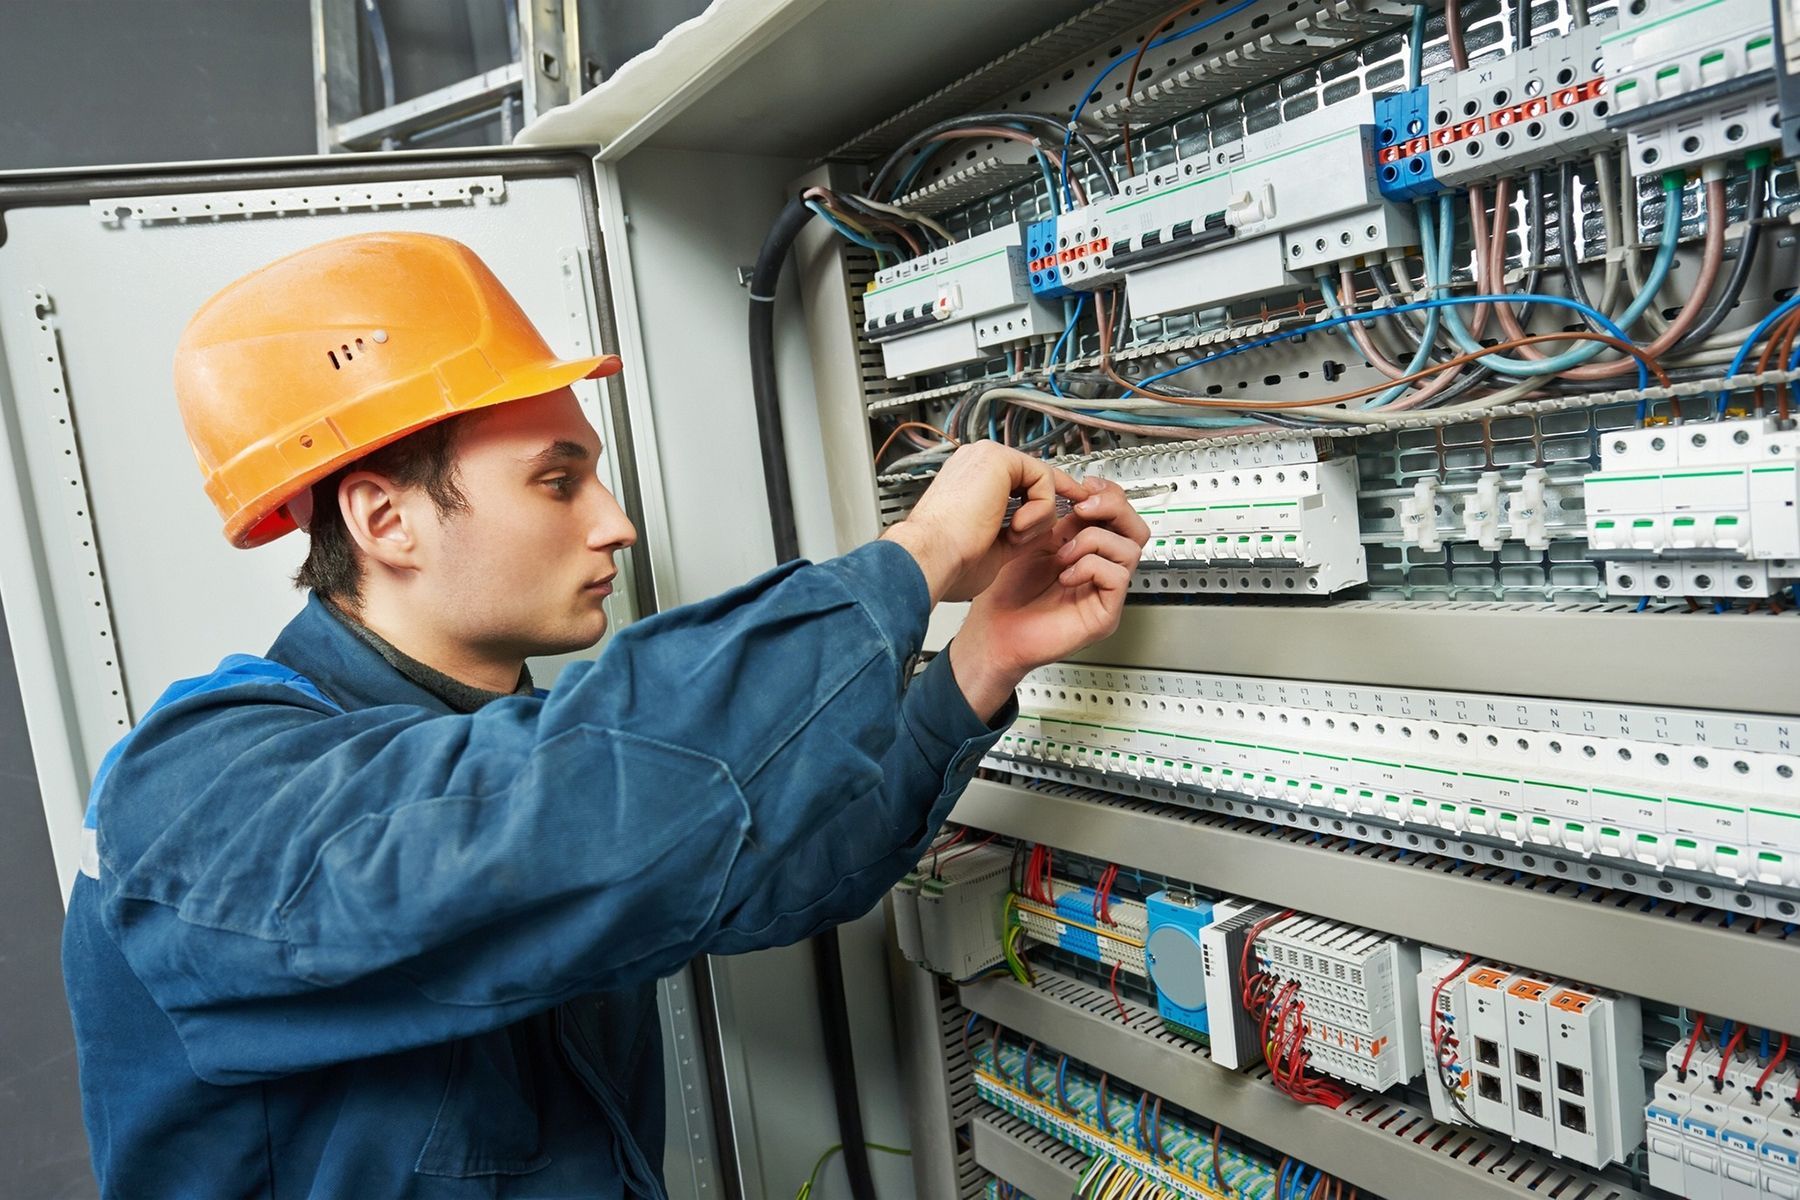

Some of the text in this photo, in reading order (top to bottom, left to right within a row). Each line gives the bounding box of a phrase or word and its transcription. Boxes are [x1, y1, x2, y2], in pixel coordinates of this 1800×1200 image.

[1480, 71, 1492, 84] X1
[1276, 442, 1282, 450] N
[1487, 703, 1494, 711] N
[1550, 708, 1558, 716] N
[1619, 714, 1628, 722] N
[1695, 720, 1704, 728] N
[1458, 712, 1467, 720] L1
[1488, 714, 1496, 722] N
[1518, 717, 1528, 726] L2
[1552, 720, 1560, 728] N
[1621, 726, 1630, 734] N
[1656, 729, 1668, 738] L1
[1697, 733, 1706, 742] N
[1735, 736, 1748, 746] L2
[1780, 740, 1790, 749] N
[1778, 727, 1788, 736] N
